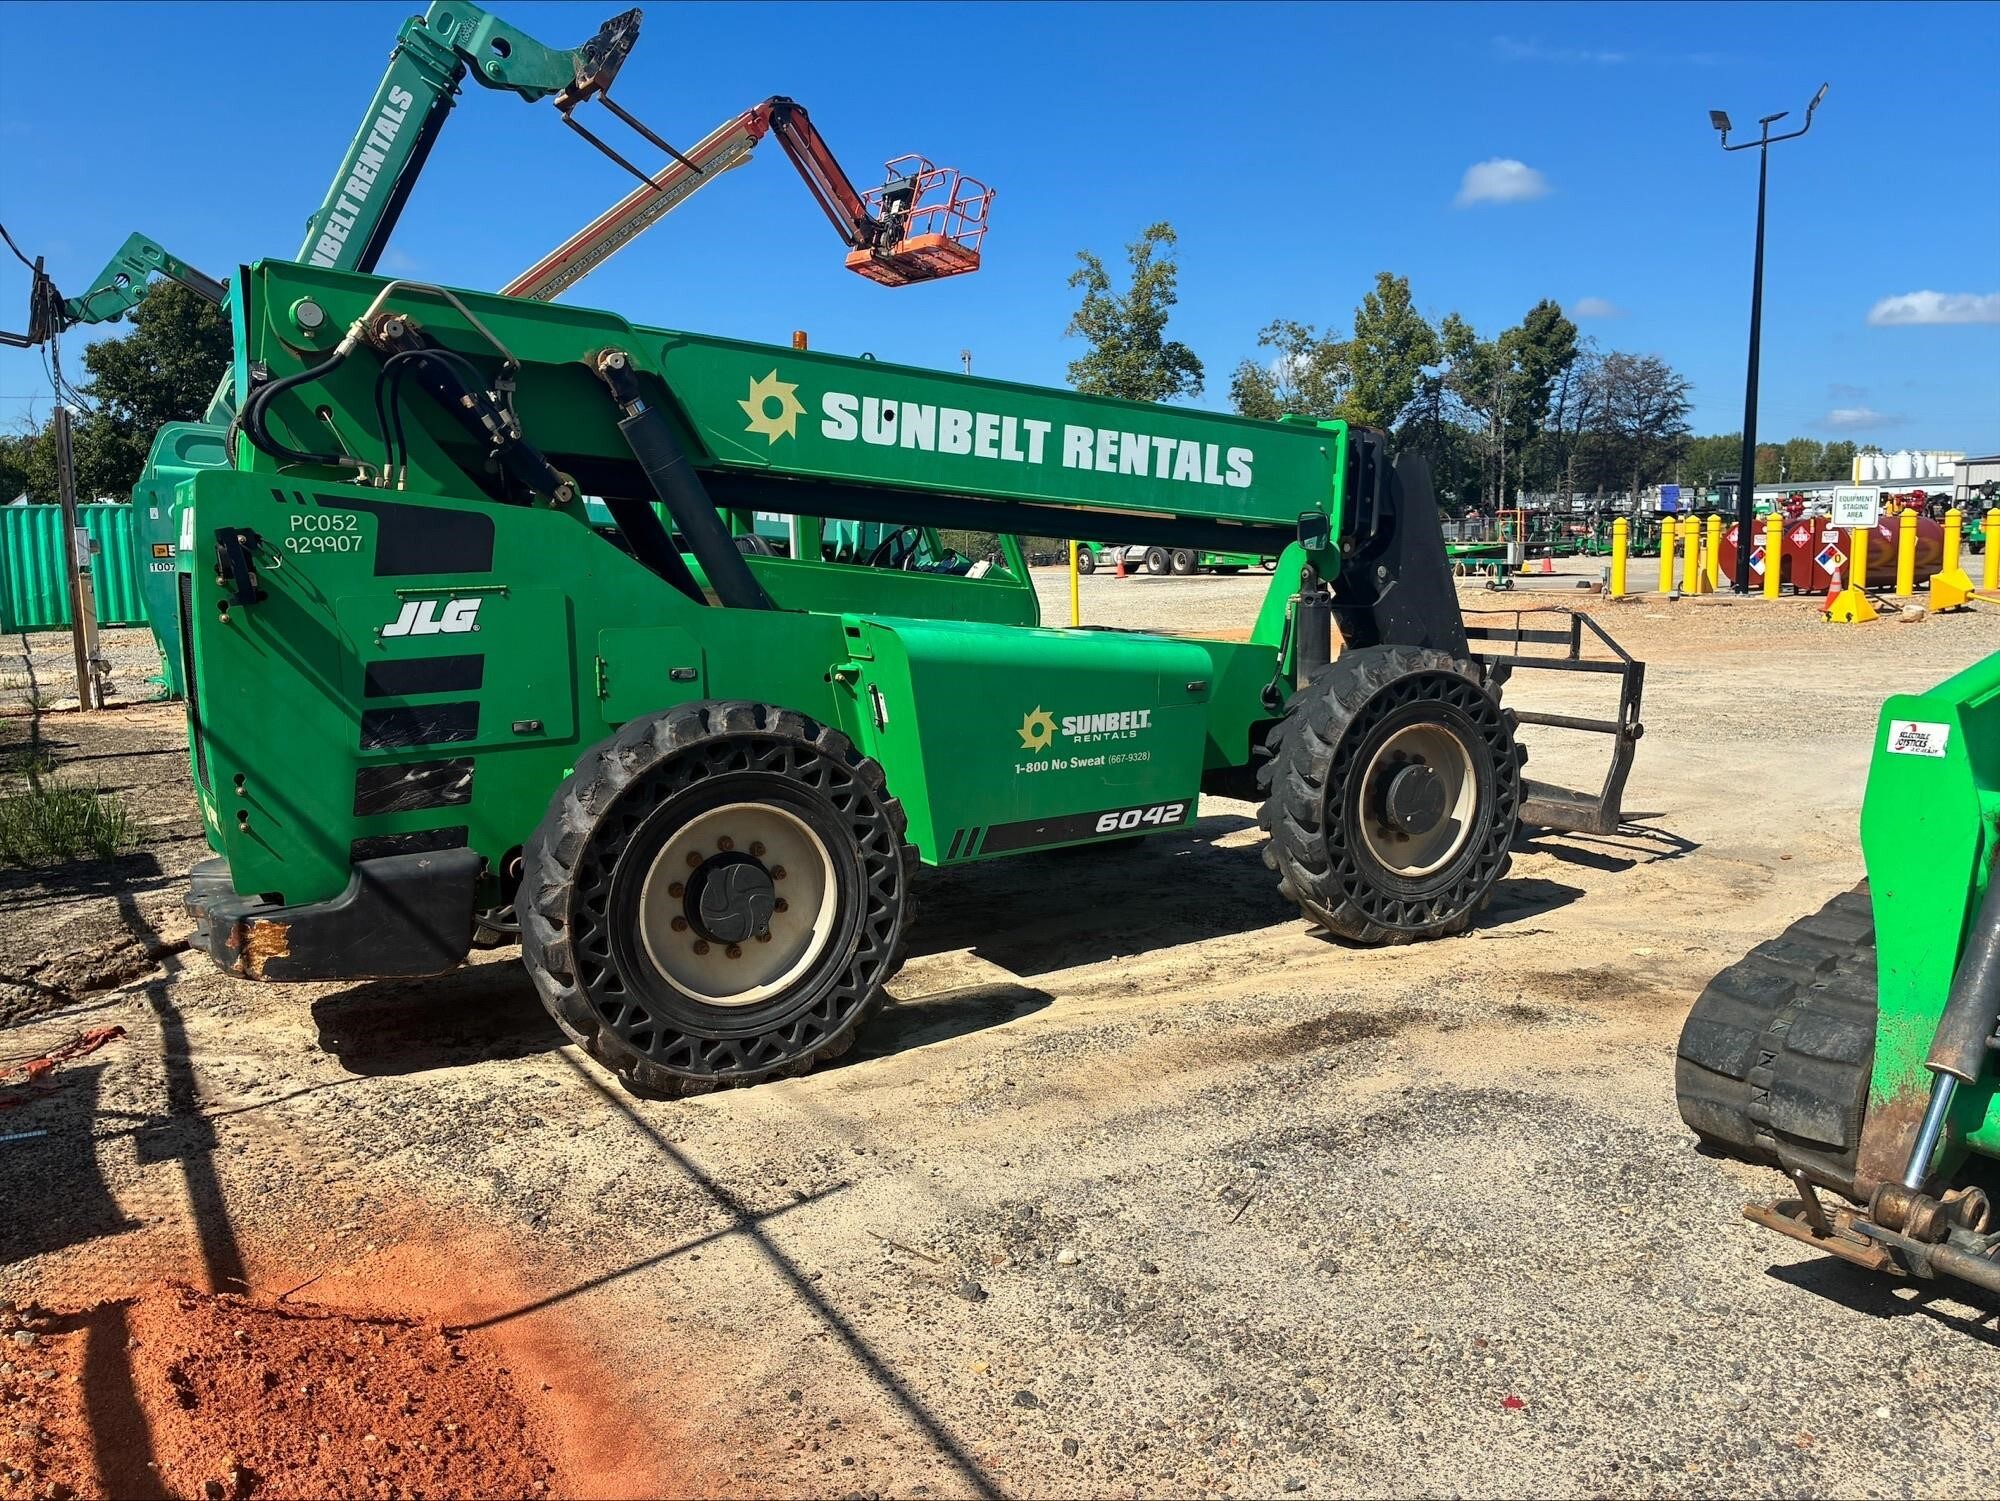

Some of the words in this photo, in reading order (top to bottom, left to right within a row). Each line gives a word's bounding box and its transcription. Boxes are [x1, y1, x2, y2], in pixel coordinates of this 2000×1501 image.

[343, 85, 414, 202] RENTALS
[820, 391, 1051, 465] SUNBELT
[1062, 424, 1254, 489] RENTALS
[1839, 495, 1874, 503] EQUIPMENT
[1842, 503, 1869, 511] STAGING
[289, 514, 358, 532] PC052
[1846, 511, 1864, 519] AREA
[284, 535, 363, 554] 929907
[381, 598, 483, 637] JLG
[1061, 709, 1151, 736] SUNBELT
[1073, 730, 1137, 744] RENTALS
[1895, 738, 1928, 748] JOYSTICKS
[1014, 761, 1048, 775] 1-800
[1051, 759, 1068, 771] No
[1070, 755, 1105, 769] Sweat
[1108, 751, 1151, 766] (667-9328)
[1095, 803, 1184, 833] 6042
